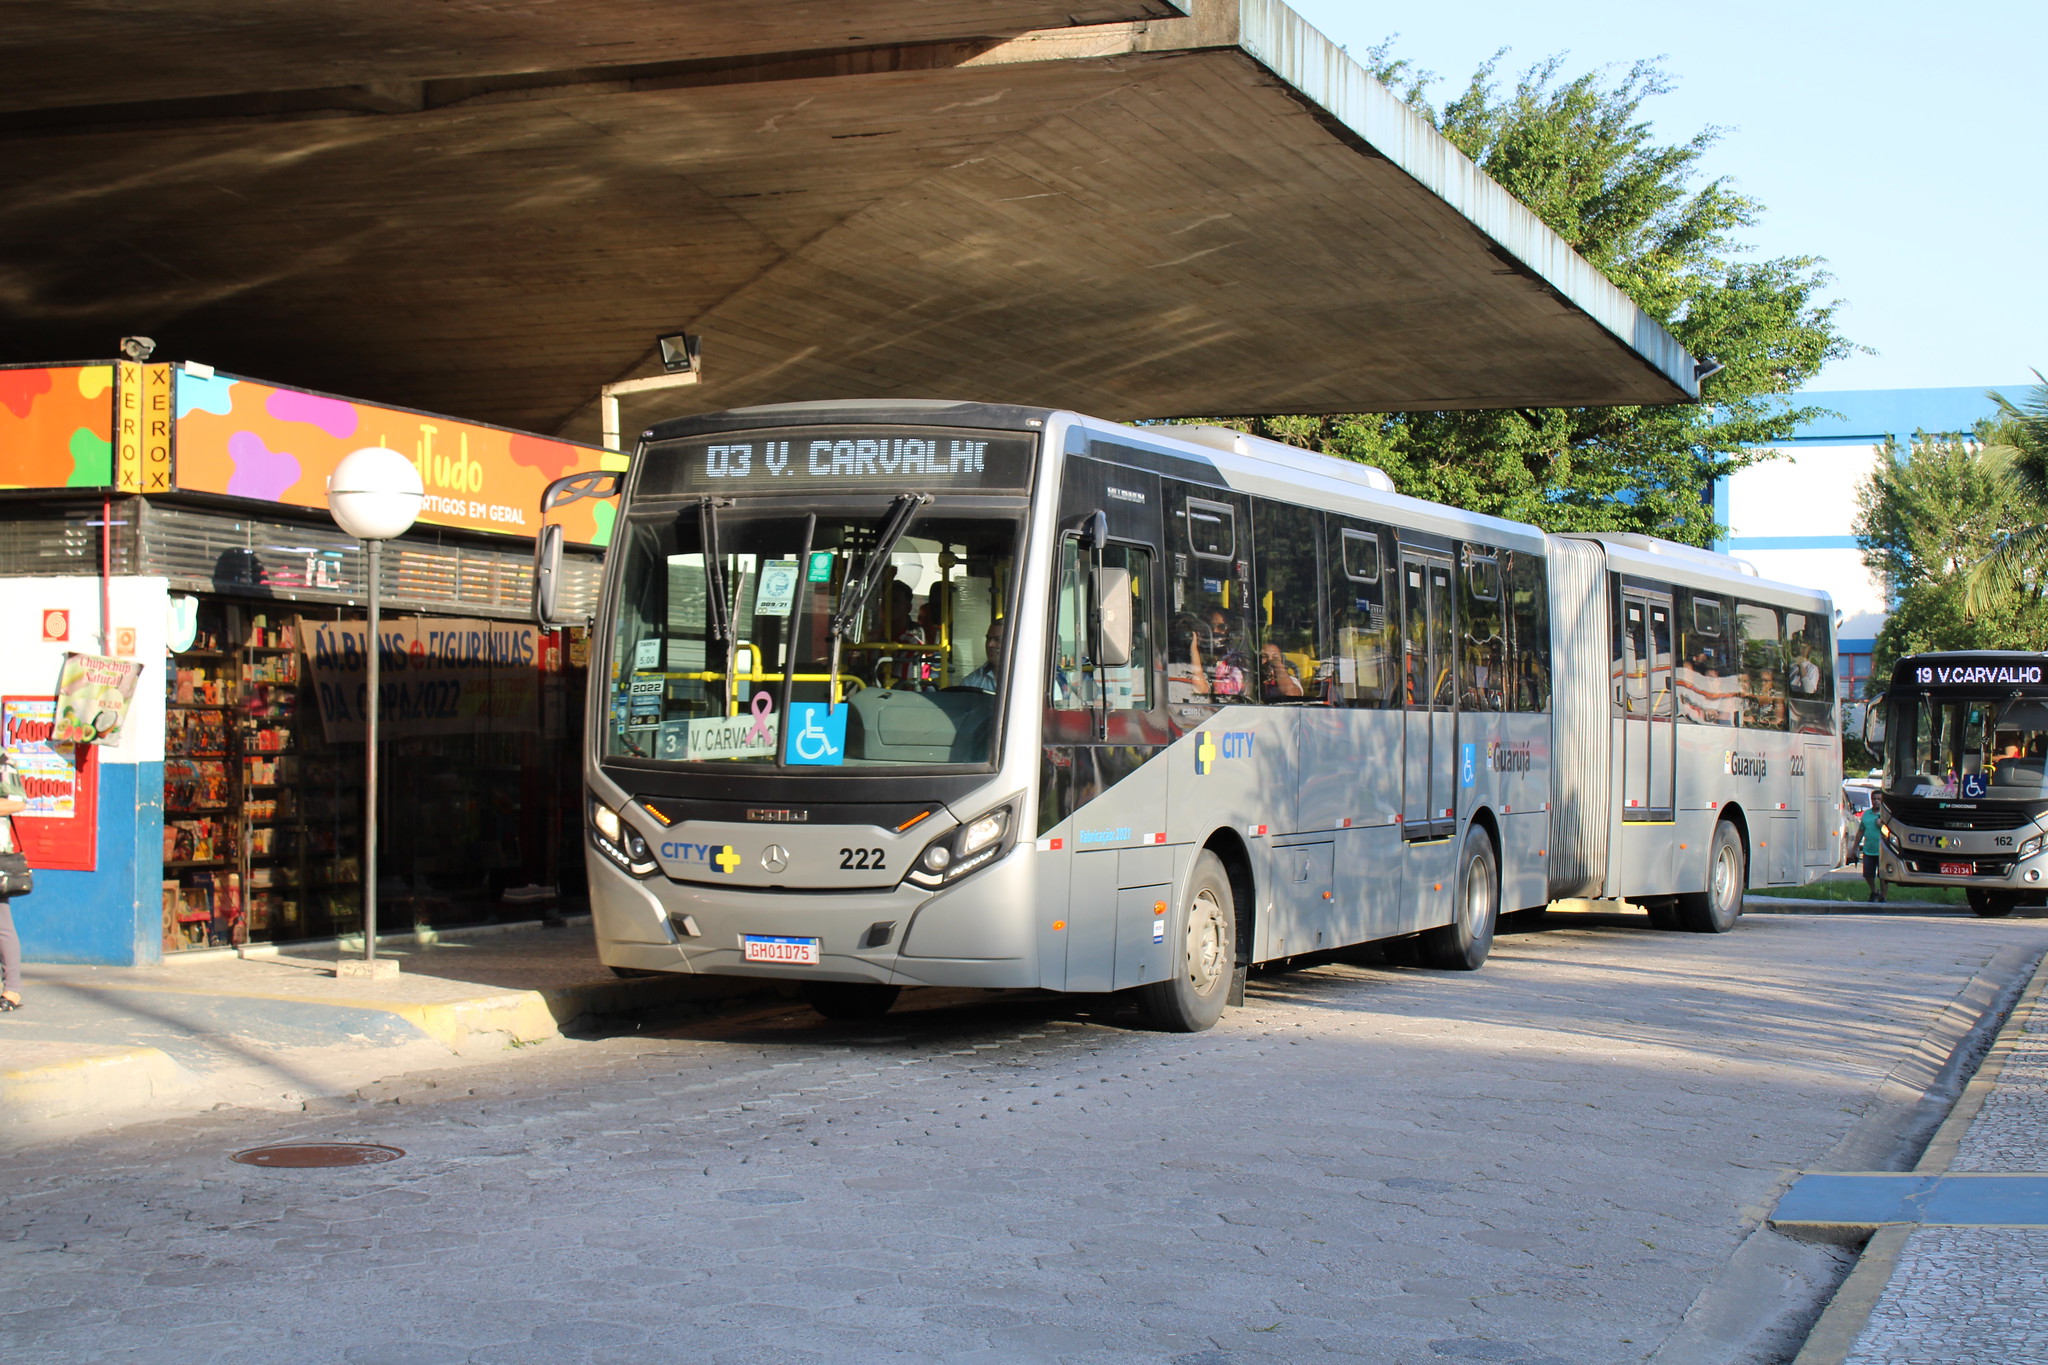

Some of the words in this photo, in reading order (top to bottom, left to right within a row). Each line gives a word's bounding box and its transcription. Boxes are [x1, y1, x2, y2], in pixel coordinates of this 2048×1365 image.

[123, 367, 135, 487] XEROX
[151, 368, 166, 488] XEROX
[706, 444, 752, 478] 03
[765, 441, 794, 476] V.
[422, 495, 467, 517] RTIGOS
[469, 501, 486, 519] EM
[489, 505, 526, 525] GERAL
[410, 640, 425, 670] e
[427, 630, 534, 670] FIGURINHAS
[80, 656, 131, 675] Chup-chup
[1916, 667, 1933, 683] 19
[86, 671, 122, 687] Natural
[633, 683, 662, 693] 2022
[320, 681, 352, 723] DA
[412, 680, 460, 719] 2022
[666, 735, 677, 753] 3
[691, 730, 702, 752] V.
[1222, 731, 1255, 759] CITY
[1493, 740, 1531, 781] Guarujá
[1731, 751, 1767, 783] Guarujá
[1791, 755, 1804, 777] 222
[660, 841, 709, 861] CITY
[1908, 833, 1936, 845] CITY
[1994, 836, 2013, 847] 162
[839, 848, 887, 871] 222
